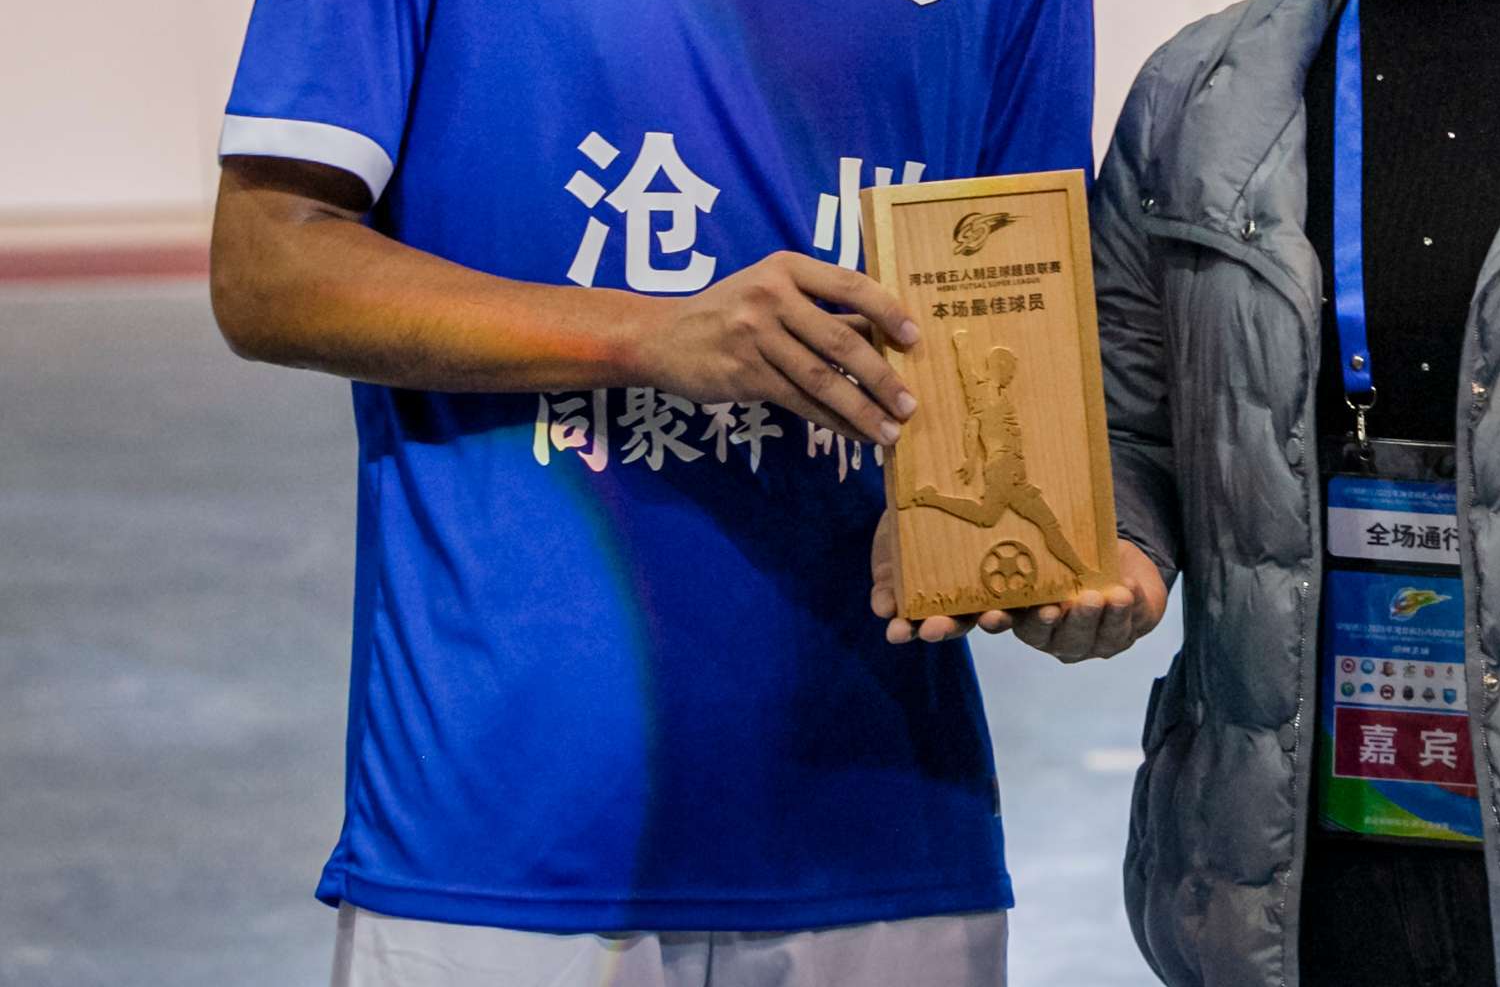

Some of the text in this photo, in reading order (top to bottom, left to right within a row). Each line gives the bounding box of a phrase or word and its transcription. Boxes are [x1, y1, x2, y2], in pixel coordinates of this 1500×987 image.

[932, 293, 1045, 320] 本场最佳球员
[1366, 522, 1460, 552] 全场通行
[1359, 723, 1458, 769] 嘉宾
